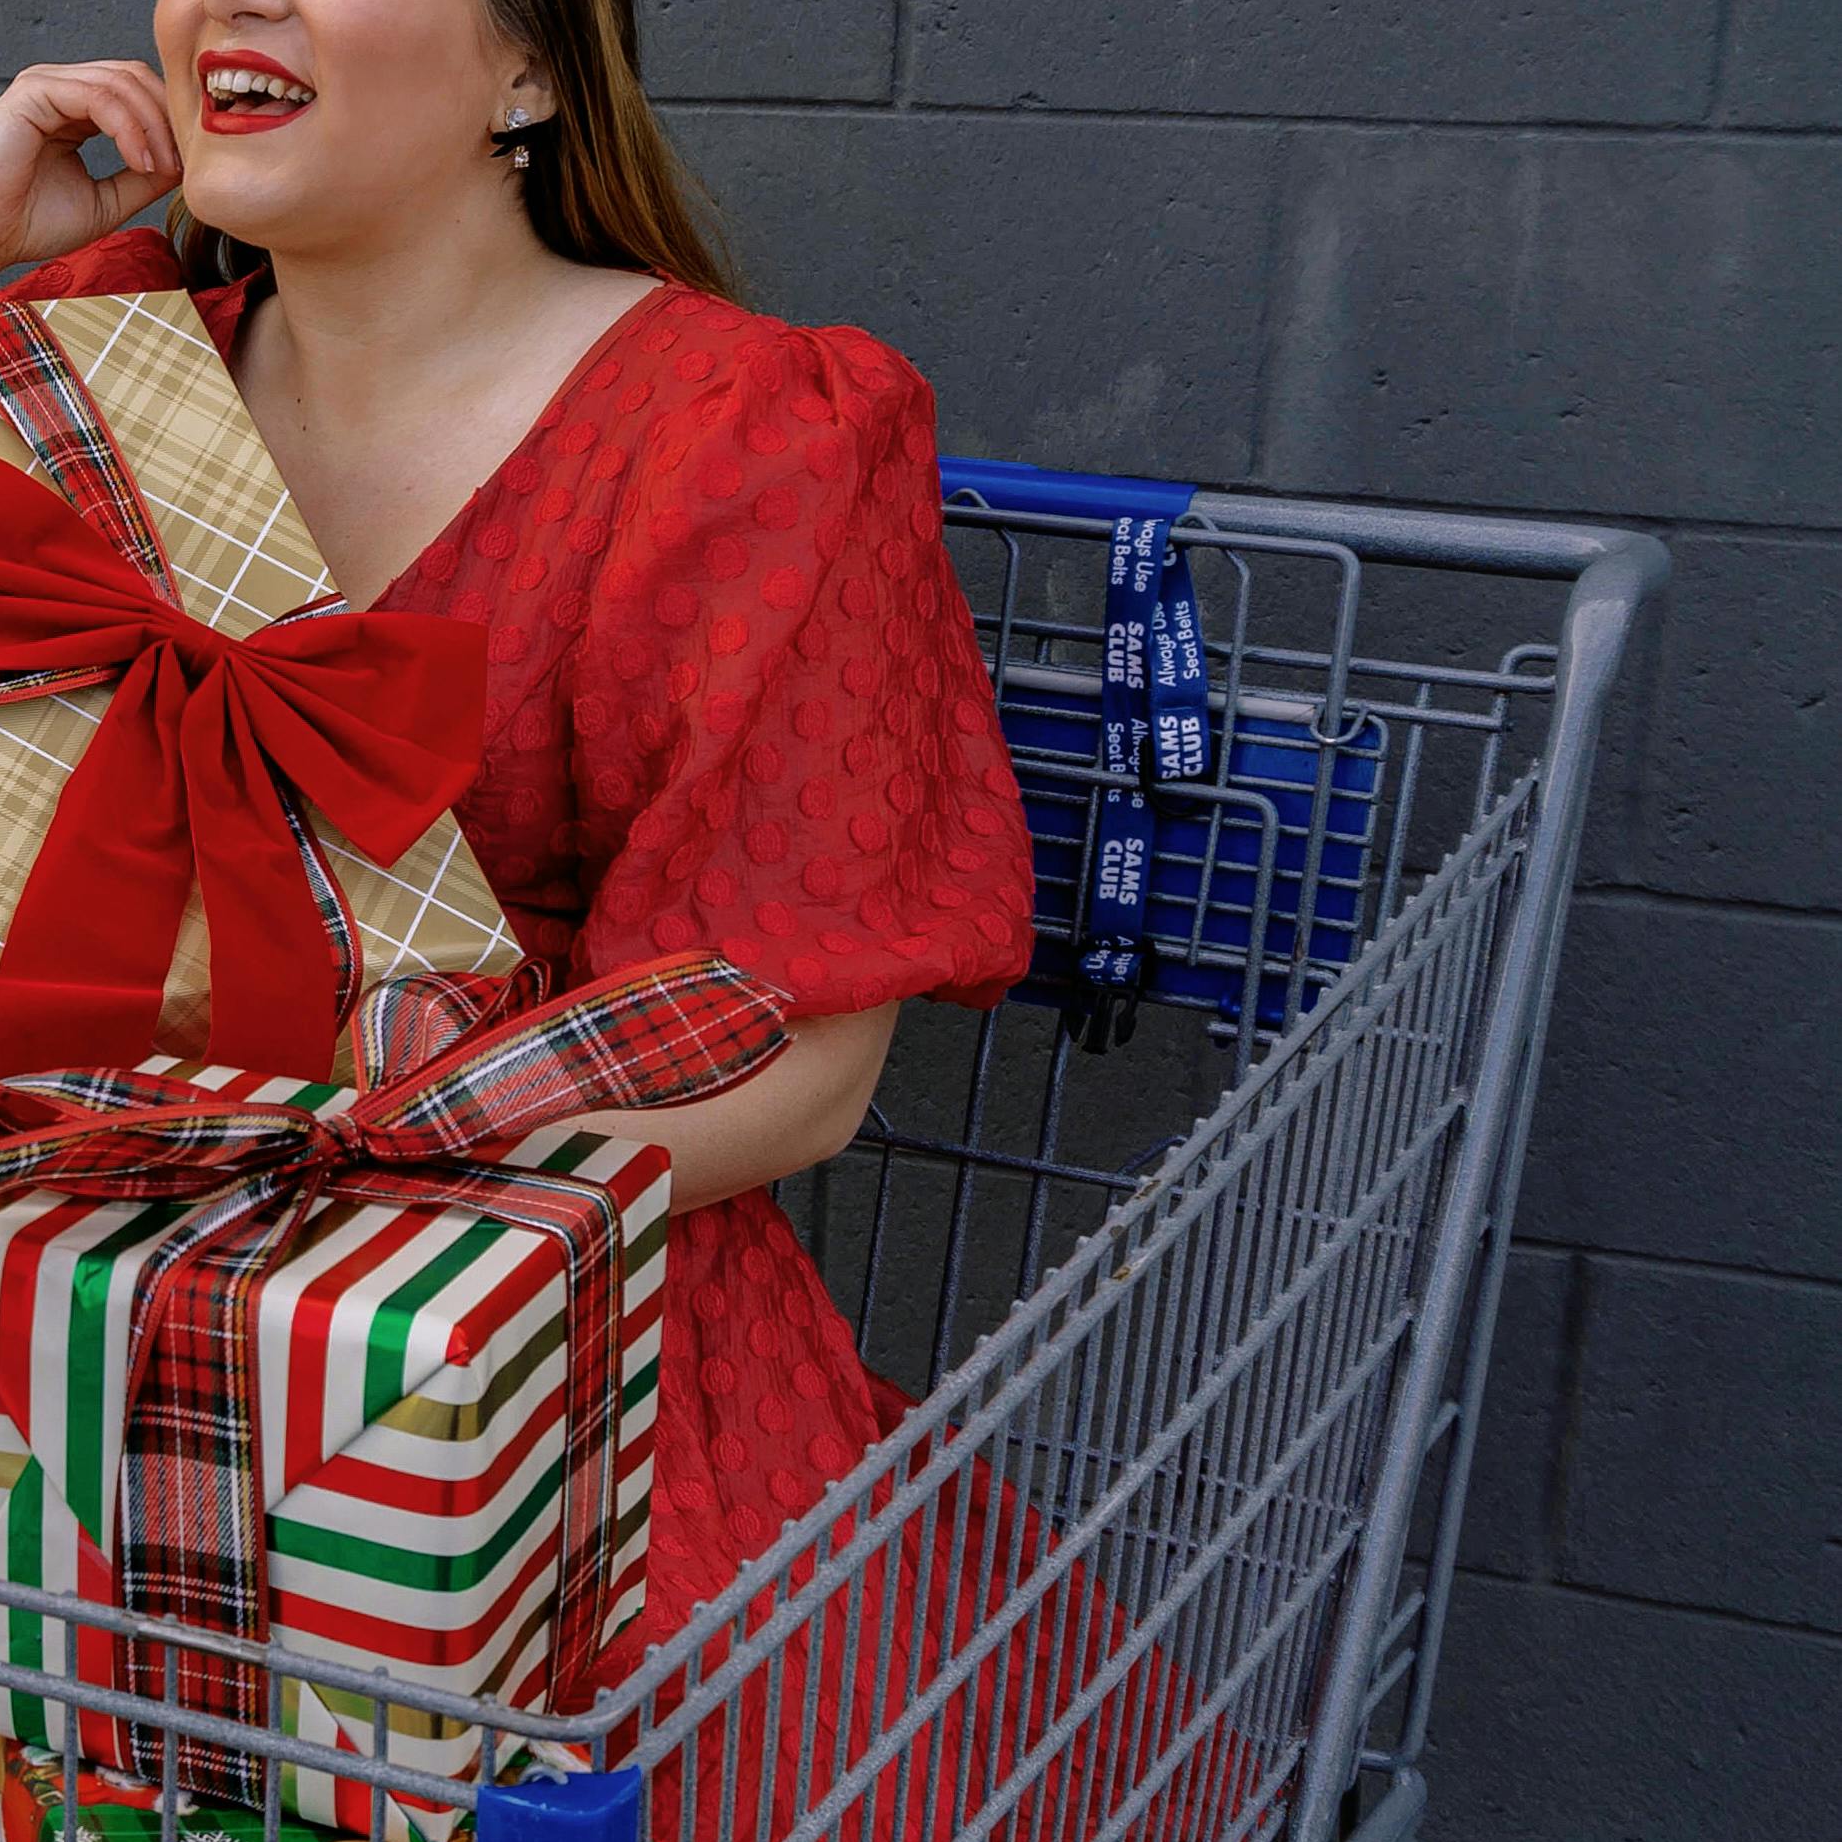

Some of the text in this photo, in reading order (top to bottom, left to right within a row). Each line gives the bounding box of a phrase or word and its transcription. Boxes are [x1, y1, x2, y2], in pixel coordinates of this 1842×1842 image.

[1111, 516, 1134, 586] eat Belts
[1133, 562, 1156, 593] Use
[1107, 623, 1127, 683] CLUB
[1126, 620, 1146, 690] SAMS
[1156, 633, 1177, 687] Always
[1174, 600, 1200, 680] Seat Belts
[1107, 722, 1125, 761] Seat
[1159, 715, 1182, 780] SAMS
[1180, 716, 1205, 778] CLUB
[1099, 840, 1124, 900] CLUB
[1119, 837, 1145, 906] SAMS
